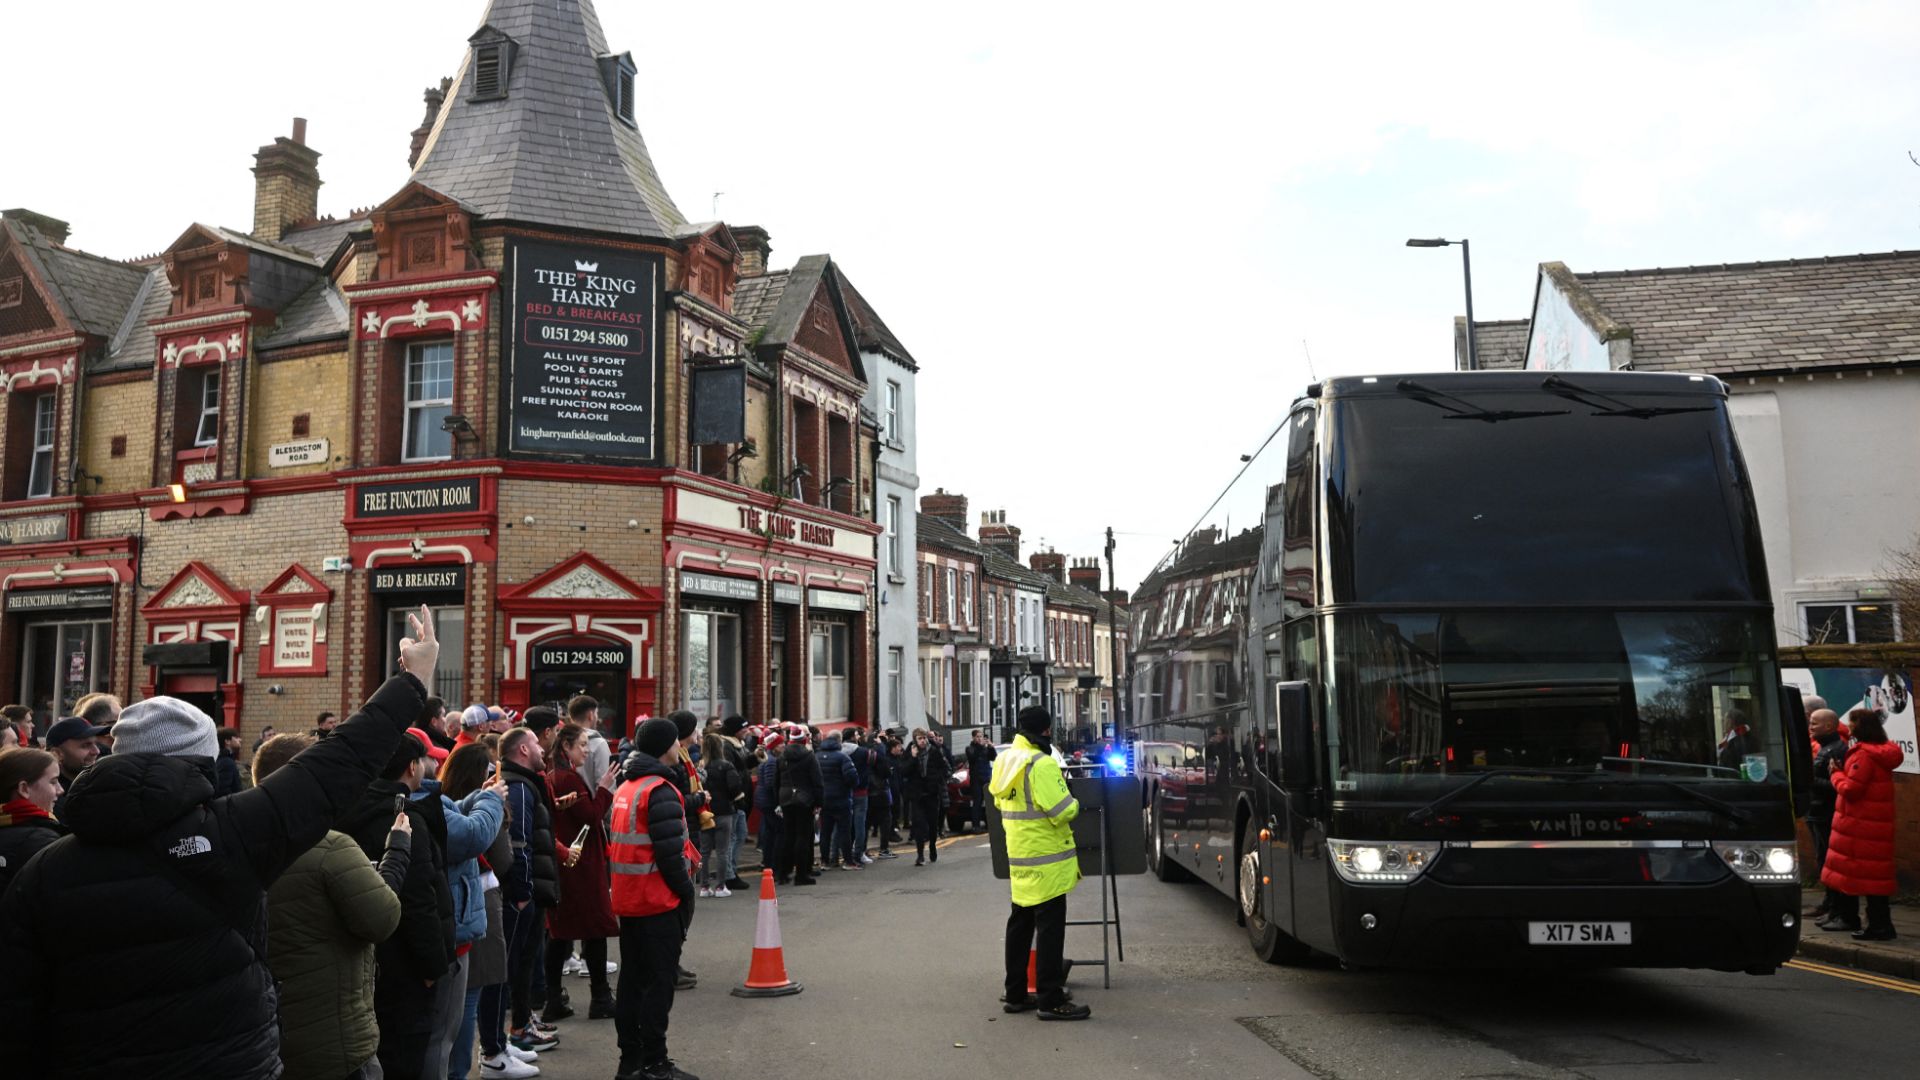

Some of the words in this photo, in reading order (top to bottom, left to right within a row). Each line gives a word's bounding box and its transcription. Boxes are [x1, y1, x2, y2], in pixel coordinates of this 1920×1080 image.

[534, 268, 577, 287] THE
[586, 275, 637, 294] KING
[552, 288, 619, 309] HARRY
[527, 303, 552, 314] BED
[557, 306, 566, 317] &
[571, 307, 643, 324] BREAKFAST
[542, 326, 569, 342] 0151
[573, 329, 595, 344] 294
[598, 332, 628, 347] 5800
[543, 351, 563, 360] ALL
[566, 353, 589, 363] LIVE
[592, 356, 626, 366] SPORT
[544, 363, 575, 373] POOL
[578, 366, 586, 374] &
[589, 367, 623, 377] DARTS
[549, 375, 570, 384] PUB
[574, 377, 618, 388] SNACKS
[540, 386, 588, 397] SUNDAY
[591, 390, 627, 399] ROAST
[522, 396, 547, 405] FREE
[550, 398, 607, 410] FUNCTION
[610, 403, 643, 412] ROOM
[557, 411, 609, 421] KARAOKE
[520, 426, 645, 443] kingharryanfield@outlook.com
[275, 443, 322, 456] BLESSINGTON
[289, 453, 308, 462] ROAD
[364, 493, 387, 512] FREE
[390, 489, 439, 510] FUNCTION
[442, 486, 471, 505] ROOM
[16, 520, 60, 538] HARRY
[738, 506, 762, 530] THE
[767, 513, 796, 539] KING
[801, 522, 835, 547] HARRY
[376, 574, 394, 588] BED
[396, 574, 403, 587] &
[405, 572, 458, 587] BREAKFAST
[23, 594, 50, 607] FUNCTION
[542, 651, 568, 664] 0151
[571, 651, 593, 664] 294
[595, 651, 624, 664] 5800
[180, 837, 195, 846] THE
[169, 844, 195, 855] NORTH
[177, 849, 196, 858] FACE
[1546, 924, 1574, 941] X17
[1580, 924, 1615, 941] SWA
